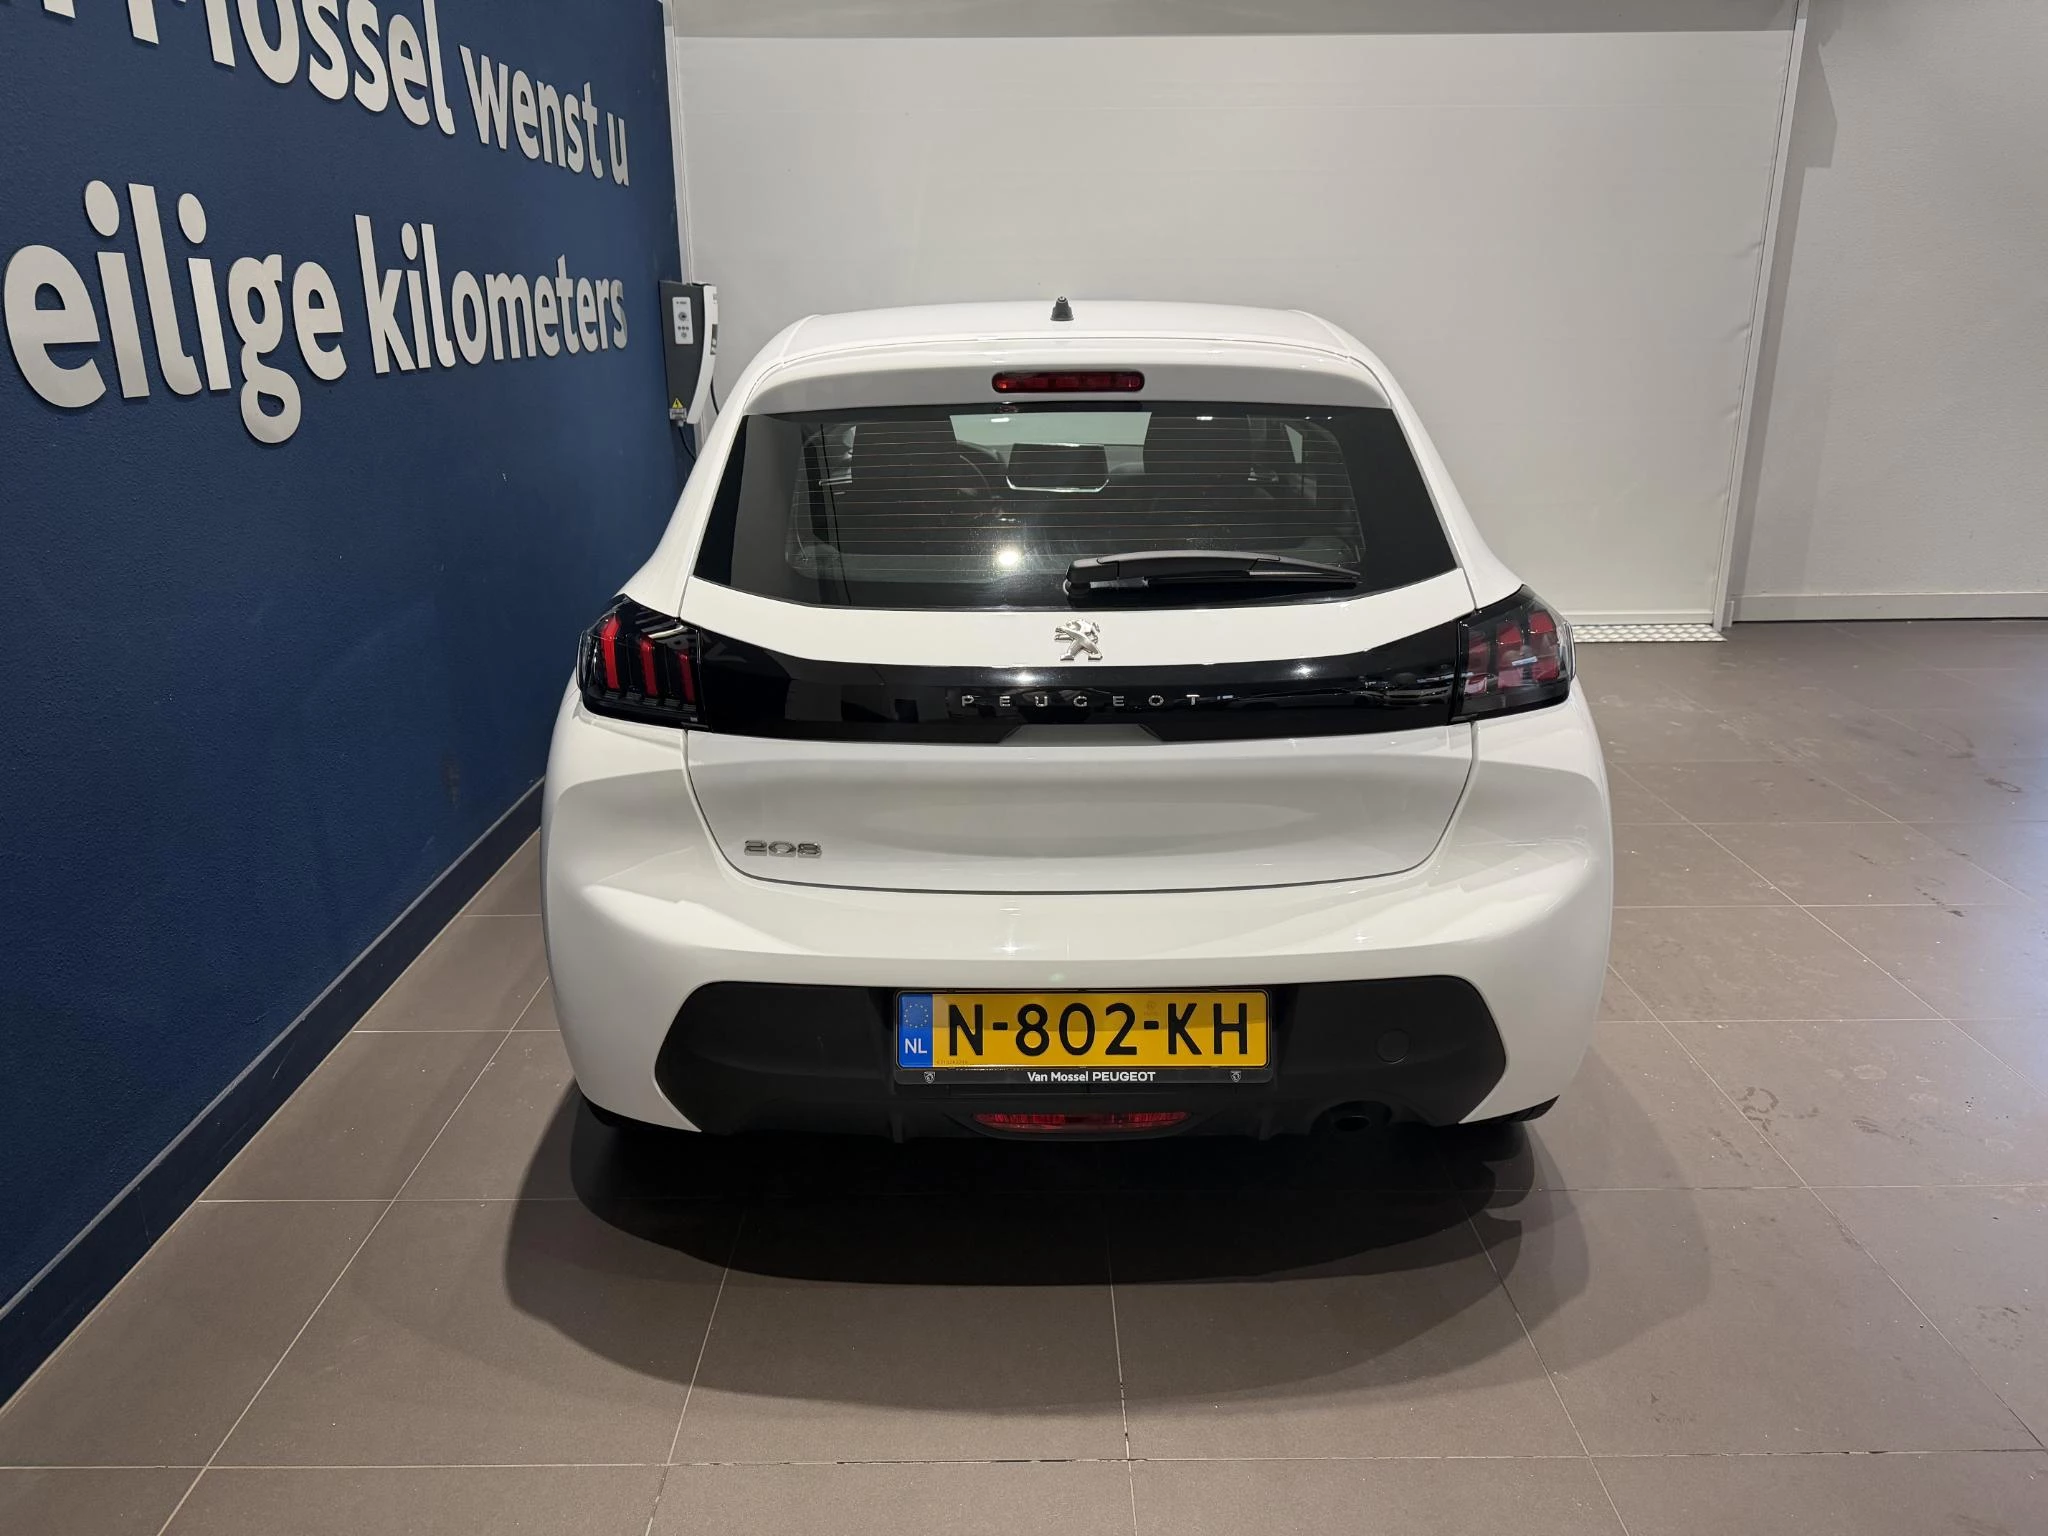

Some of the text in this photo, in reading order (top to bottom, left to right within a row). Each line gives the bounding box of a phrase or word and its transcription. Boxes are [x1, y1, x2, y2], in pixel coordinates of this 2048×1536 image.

[459, 45, 604, 178] wenst
[607, 112, 629, 186] u
[4, 180, 627, 443] eilige kilometers
[961, 694, 1200, 708] PEUGEOT
[744, 839, 822, 859] 208
[948, 1002, 1248, 1057] N-802-KH
[904, 1037, 928, 1055] NL
[1027, 1070, 1156, 1082] Van Mossel PEUGEOT
